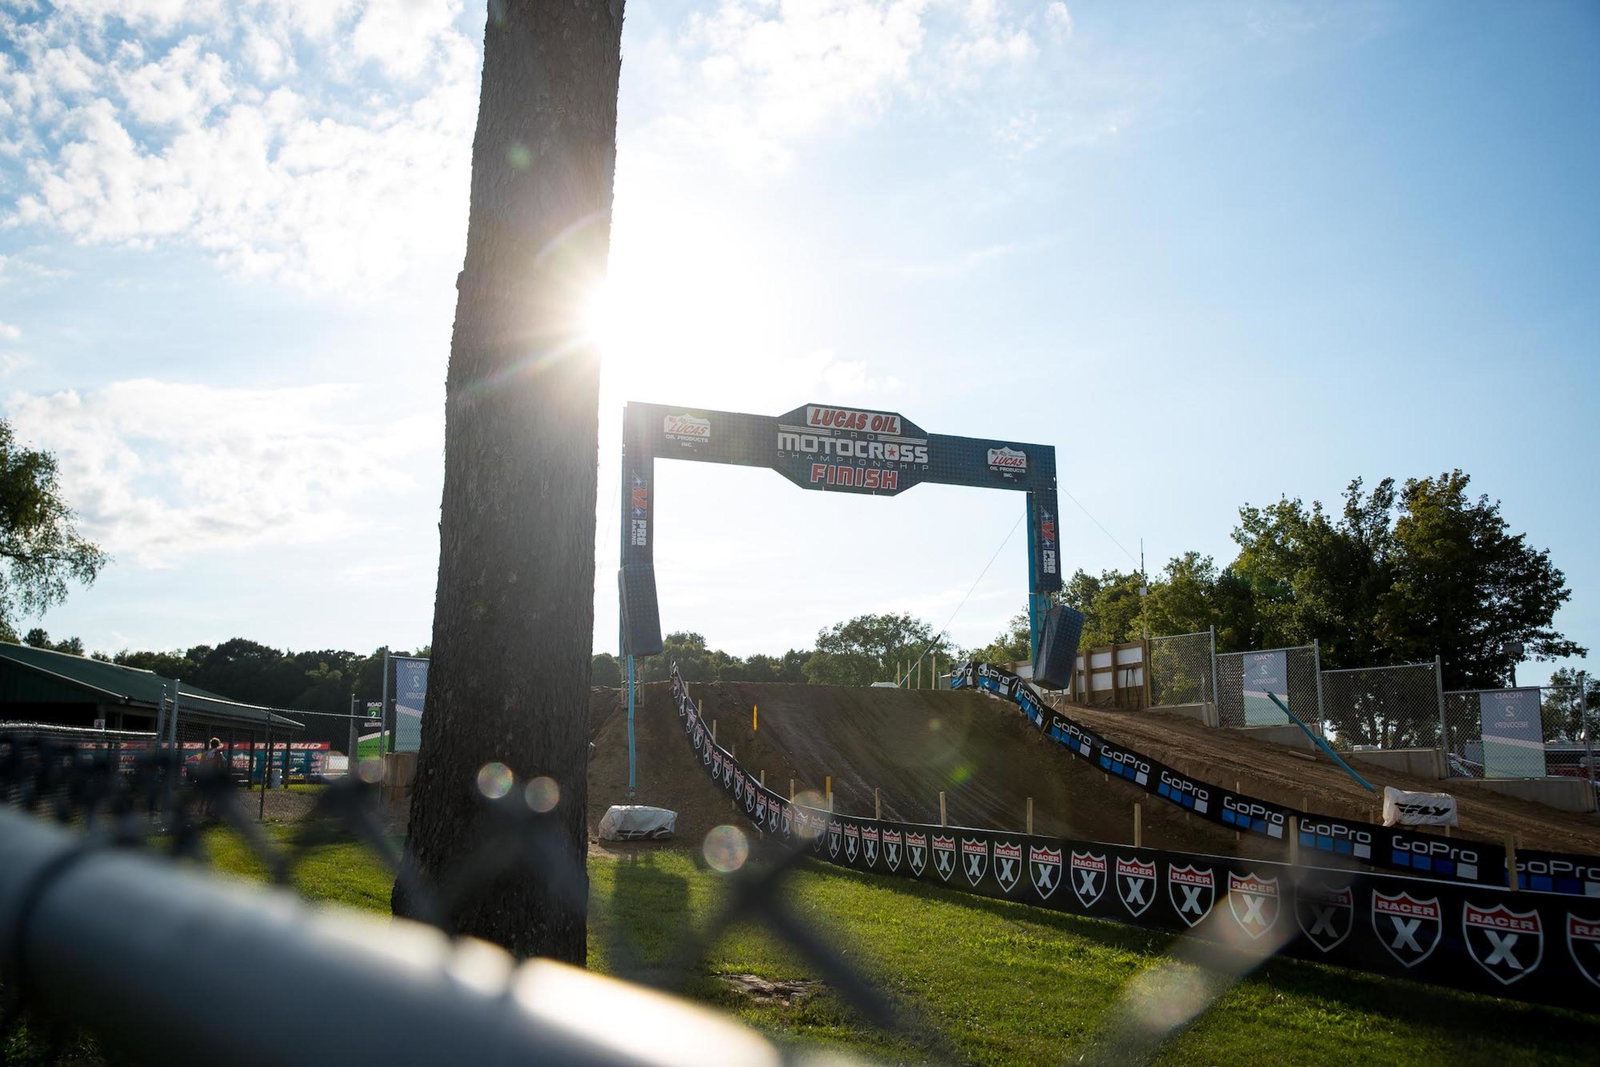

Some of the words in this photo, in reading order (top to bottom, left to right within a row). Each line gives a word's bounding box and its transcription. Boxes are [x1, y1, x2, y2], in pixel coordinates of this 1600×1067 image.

[671, 423, 709, 436] LUCAS
[811, 408, 869, 430] LUCAS
[870, 415, 898, 433] OIL
[834, 430, 875, 441] PRO
[777, 432, 929, 464] MOTOCROSS
[777, 450, 930, 472] CHAMPIONSHIP
[991, 456, 1025, 467] LUCAS
[810, 463, 899, 490] FINISH
[637, 520, 647, 546] PRO
[1048, 550, 1056, 574] PRO
[977, 666, 1010, 684] GoPro
[1053, 716, 1092, 746] GoPro
[1100, 745, 1150, 774] GoPro
[1160, 771, 1209, 801] GoPro
[1223, 796, 1285, 824] GoPro
[831, 833, 838, 850] X
[907, 838, 925, 846] RACER
[1300, 818, 1372, 844] GoPro
[848, 837, 855, 854] X
[867, 840, 874, 859] X
[888, 843, 897, 863] X
[912, 846, 923, 867] X
[934, 841, 953, 850] RACER
[964, 845, 986, 853] RACER
[996, 848, 1020, 857] RACER
[1391, 834, 1479, 863] GoPro
[938, 851, 950, 872] X
[968, 854, 980, 877] X
[1032, 853, 1060, 863] RACER
[1074, 858, 1105, 870] RACER
[1000, 859, 1014, 882] X
[1037, 864, 1053, 889] X
[1118, 865, 1154, 876] RACER
[1171, 872, 1211, 885] RACER
[1079, 870, 1097, 896] X
[1126, 876, 1146, 905] X
[1231, 880, 1276, 894] RACER
[1180, 885, 1203, 915] X
[1242, 894, 1266, 926] X
[1377, 900, 1435, 917] RACER
[1309, 904, 1338, 939] X
[1469, 913, 1536, 931] RACER
[1390, 915, 1424, 953] X
[1483, 929, 1524, 970] X
